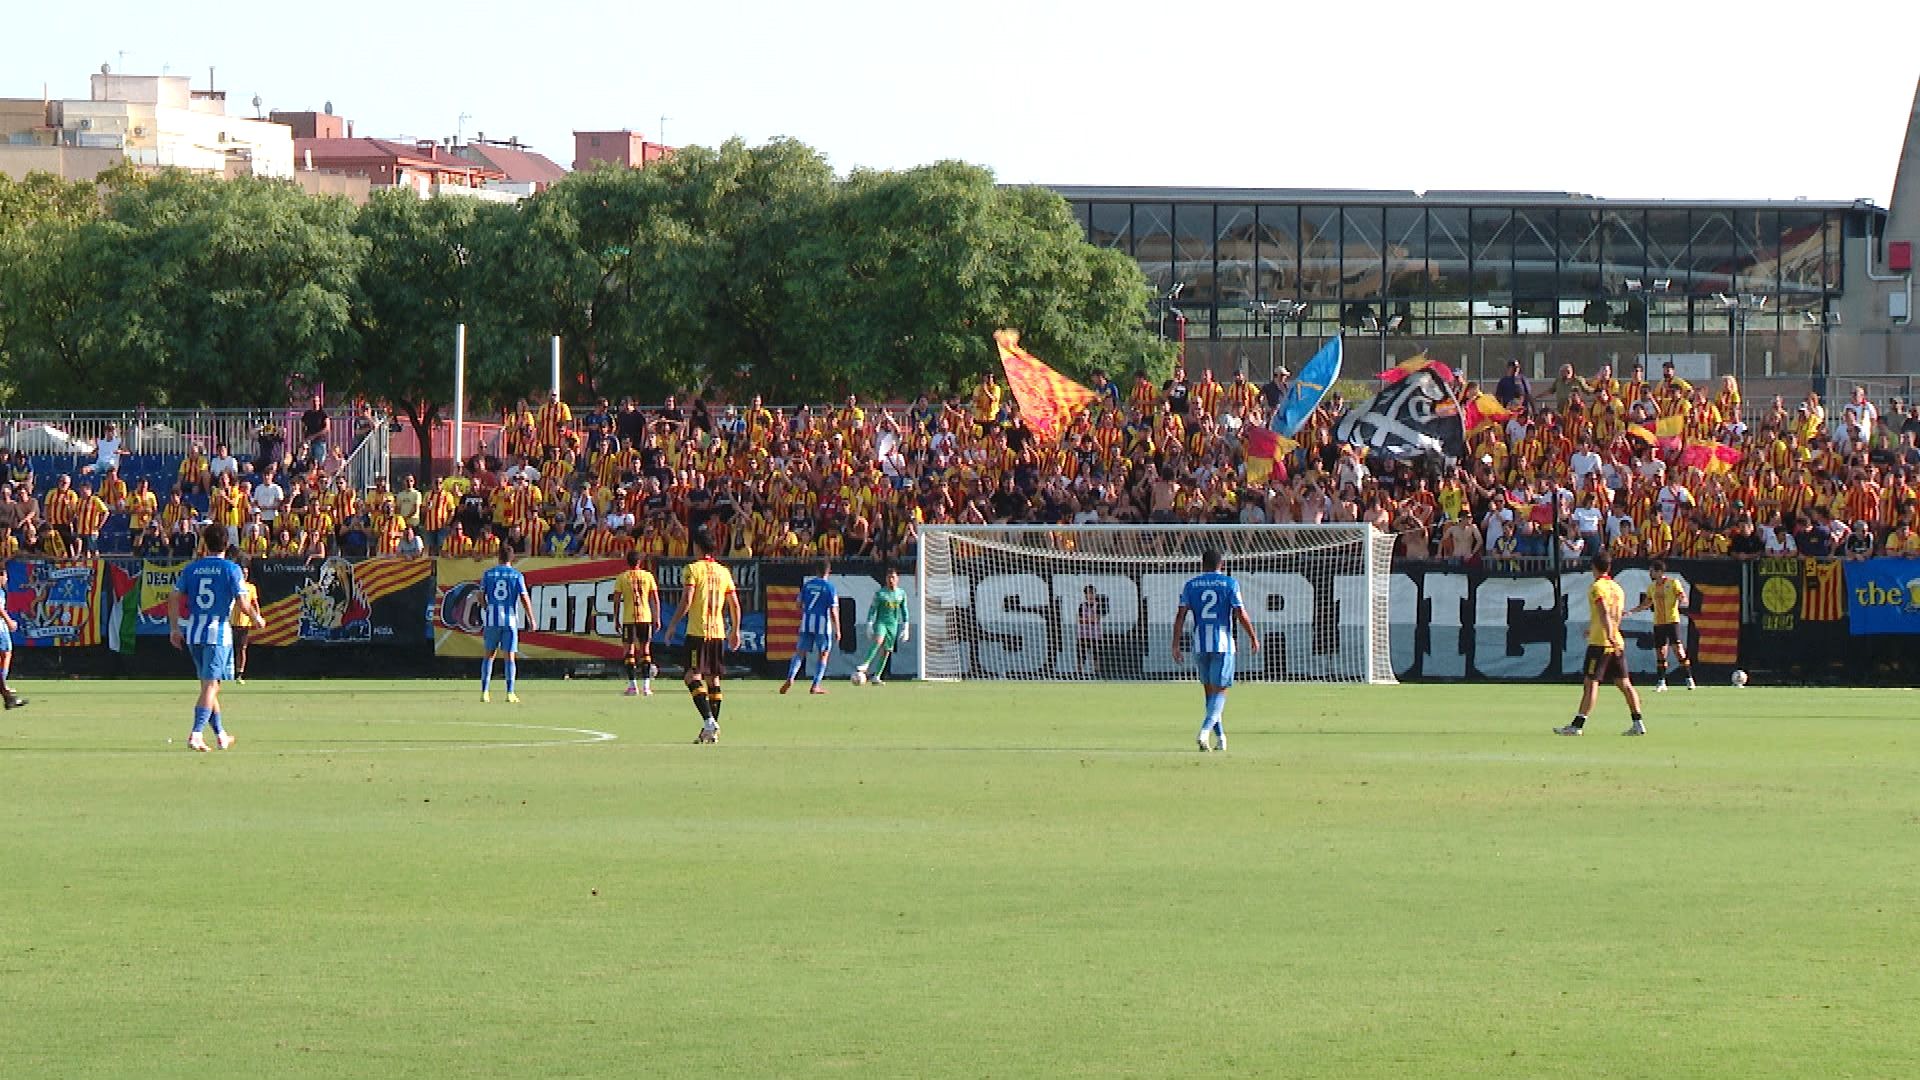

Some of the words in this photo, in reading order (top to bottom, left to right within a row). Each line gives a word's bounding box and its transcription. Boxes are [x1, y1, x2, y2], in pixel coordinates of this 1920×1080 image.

[196, 578, 214, 609] 5
[494, 580, 508, 600] 8
[807, 592, 820, 611] 7
[1856, 581, 1902, 605] the
[1201, 590, 1217, 618] 2
